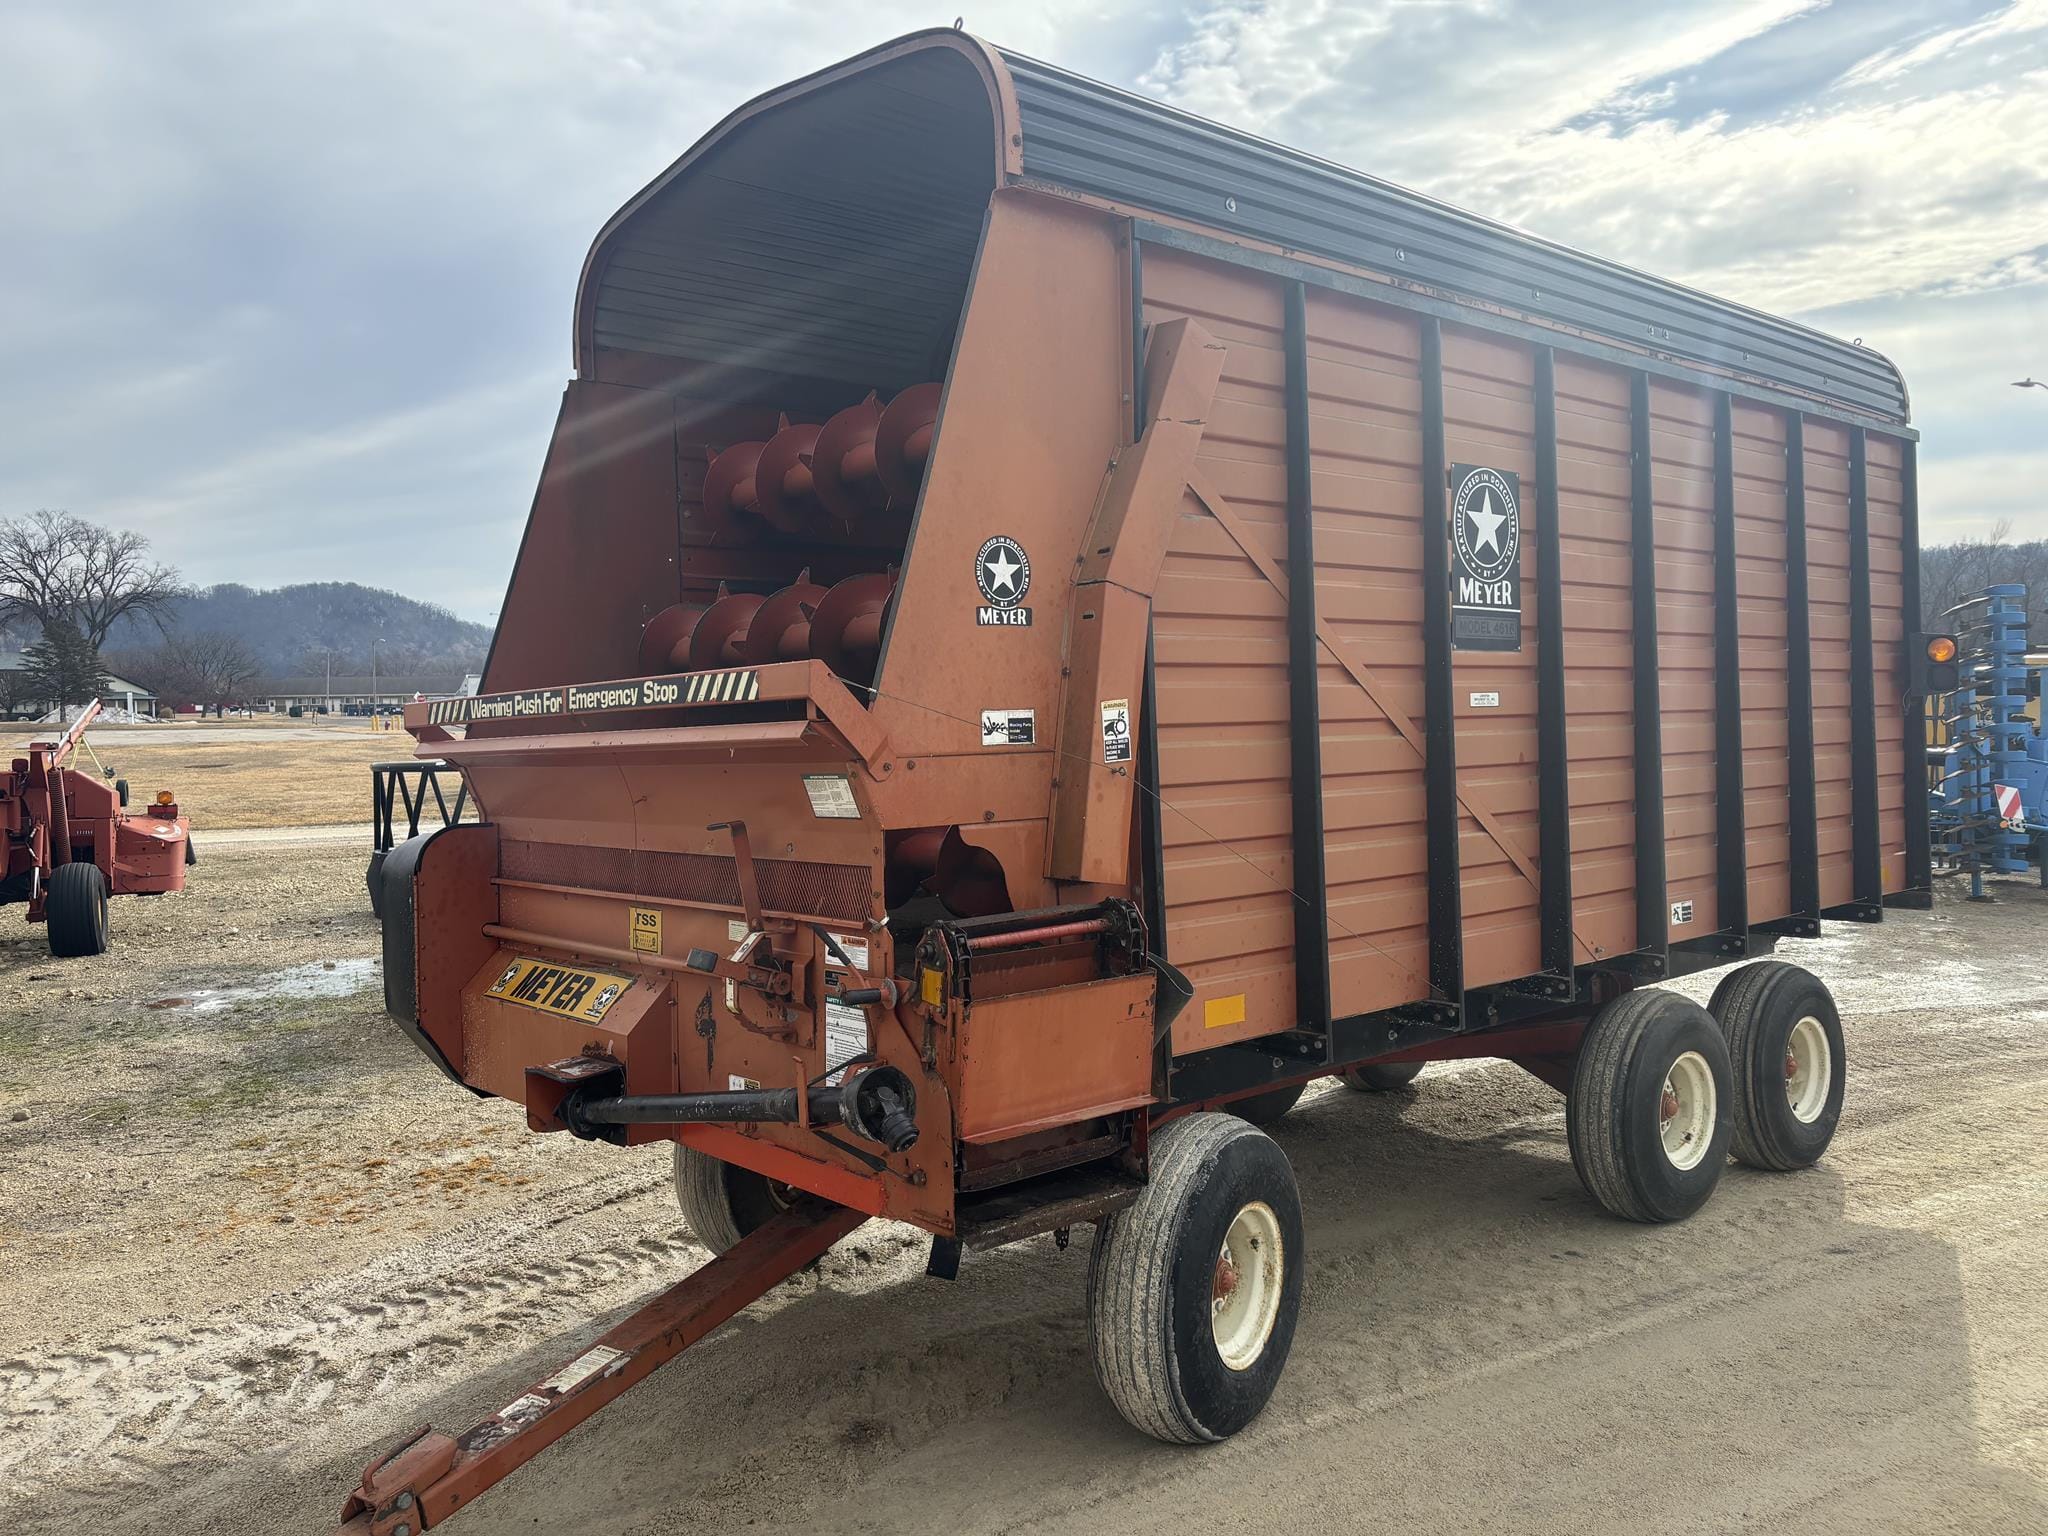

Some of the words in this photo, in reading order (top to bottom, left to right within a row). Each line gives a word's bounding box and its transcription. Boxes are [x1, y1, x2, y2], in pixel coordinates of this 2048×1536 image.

[1456, 475, 1480, 553] MANUFACTURED
[1481, 473, 1488, 482] IN
[1490, 475, 1516, 534] DORCHESTER
[976, 537, 997, 587] MANUFACTURED
[1006, 538, 1030, 575] DORCHESTER
[1483, 569, 1491, 577] BY
[1459, 576, 1512, 605] MEYER
[979, 607, 1027, 625] MEYER
[1459, 619, 1491, 634] MODEL
[470, 695, 513, 719] Warning
[514, 694, 542, 716] Push
[543, 694, 563, 713] For
[569, 687, 639, 710] Emergency
[643, 680, 678, 704] Stop
[509, 965, 596, 1012] MEYER
